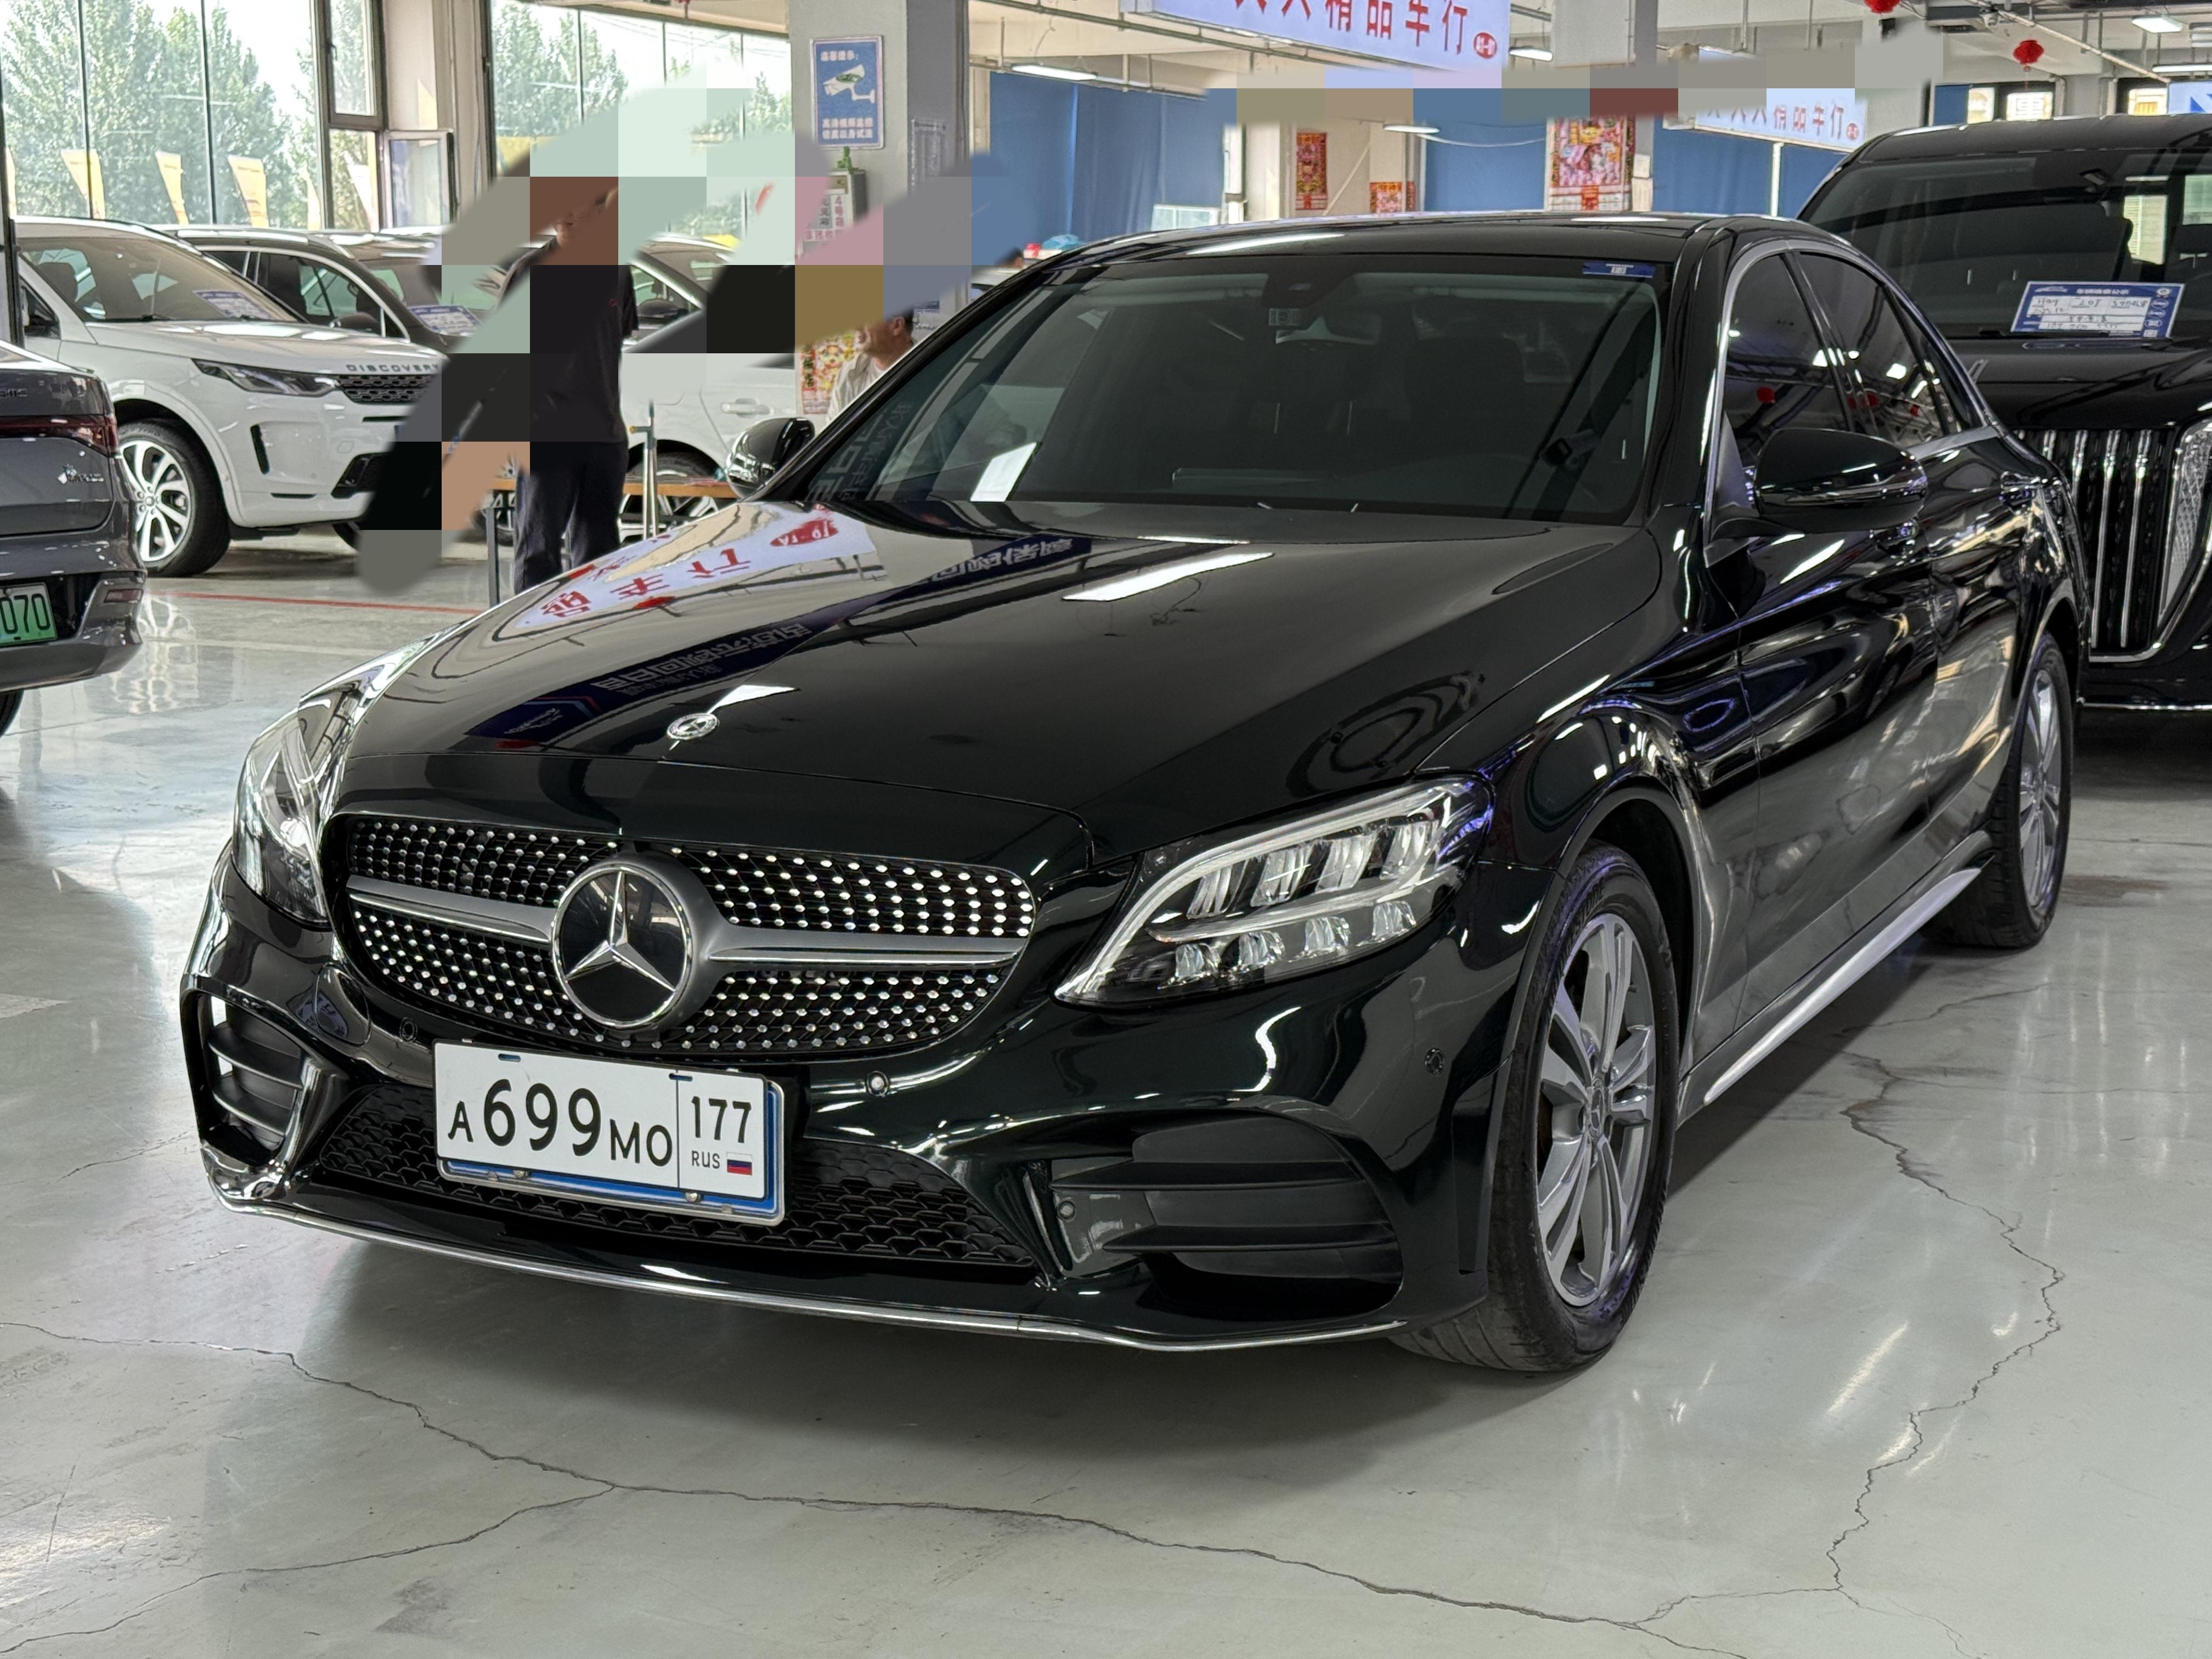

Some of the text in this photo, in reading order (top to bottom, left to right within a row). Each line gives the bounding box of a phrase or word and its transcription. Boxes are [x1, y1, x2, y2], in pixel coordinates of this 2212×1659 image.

[346, 363, 438, 373] DISCOVERY
[448, 1079, 752, 1167] A699MO 177
[691, 1150, 721, 1169] RUS
